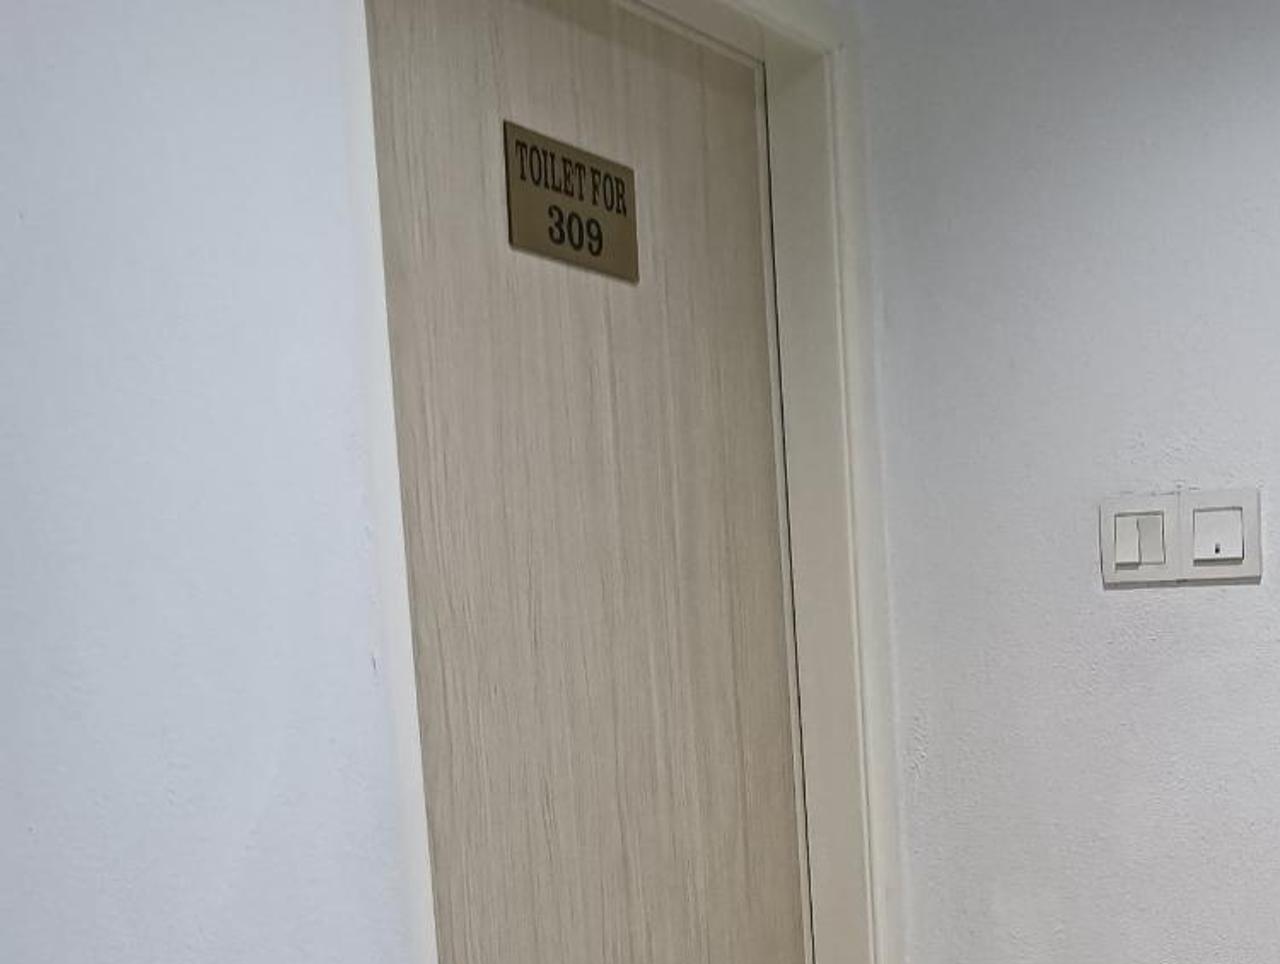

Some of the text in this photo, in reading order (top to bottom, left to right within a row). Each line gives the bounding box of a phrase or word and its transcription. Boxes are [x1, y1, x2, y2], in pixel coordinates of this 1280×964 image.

[515, 139, 627, 217] TOILET FOR
[548, 204, 603, 257] 309
